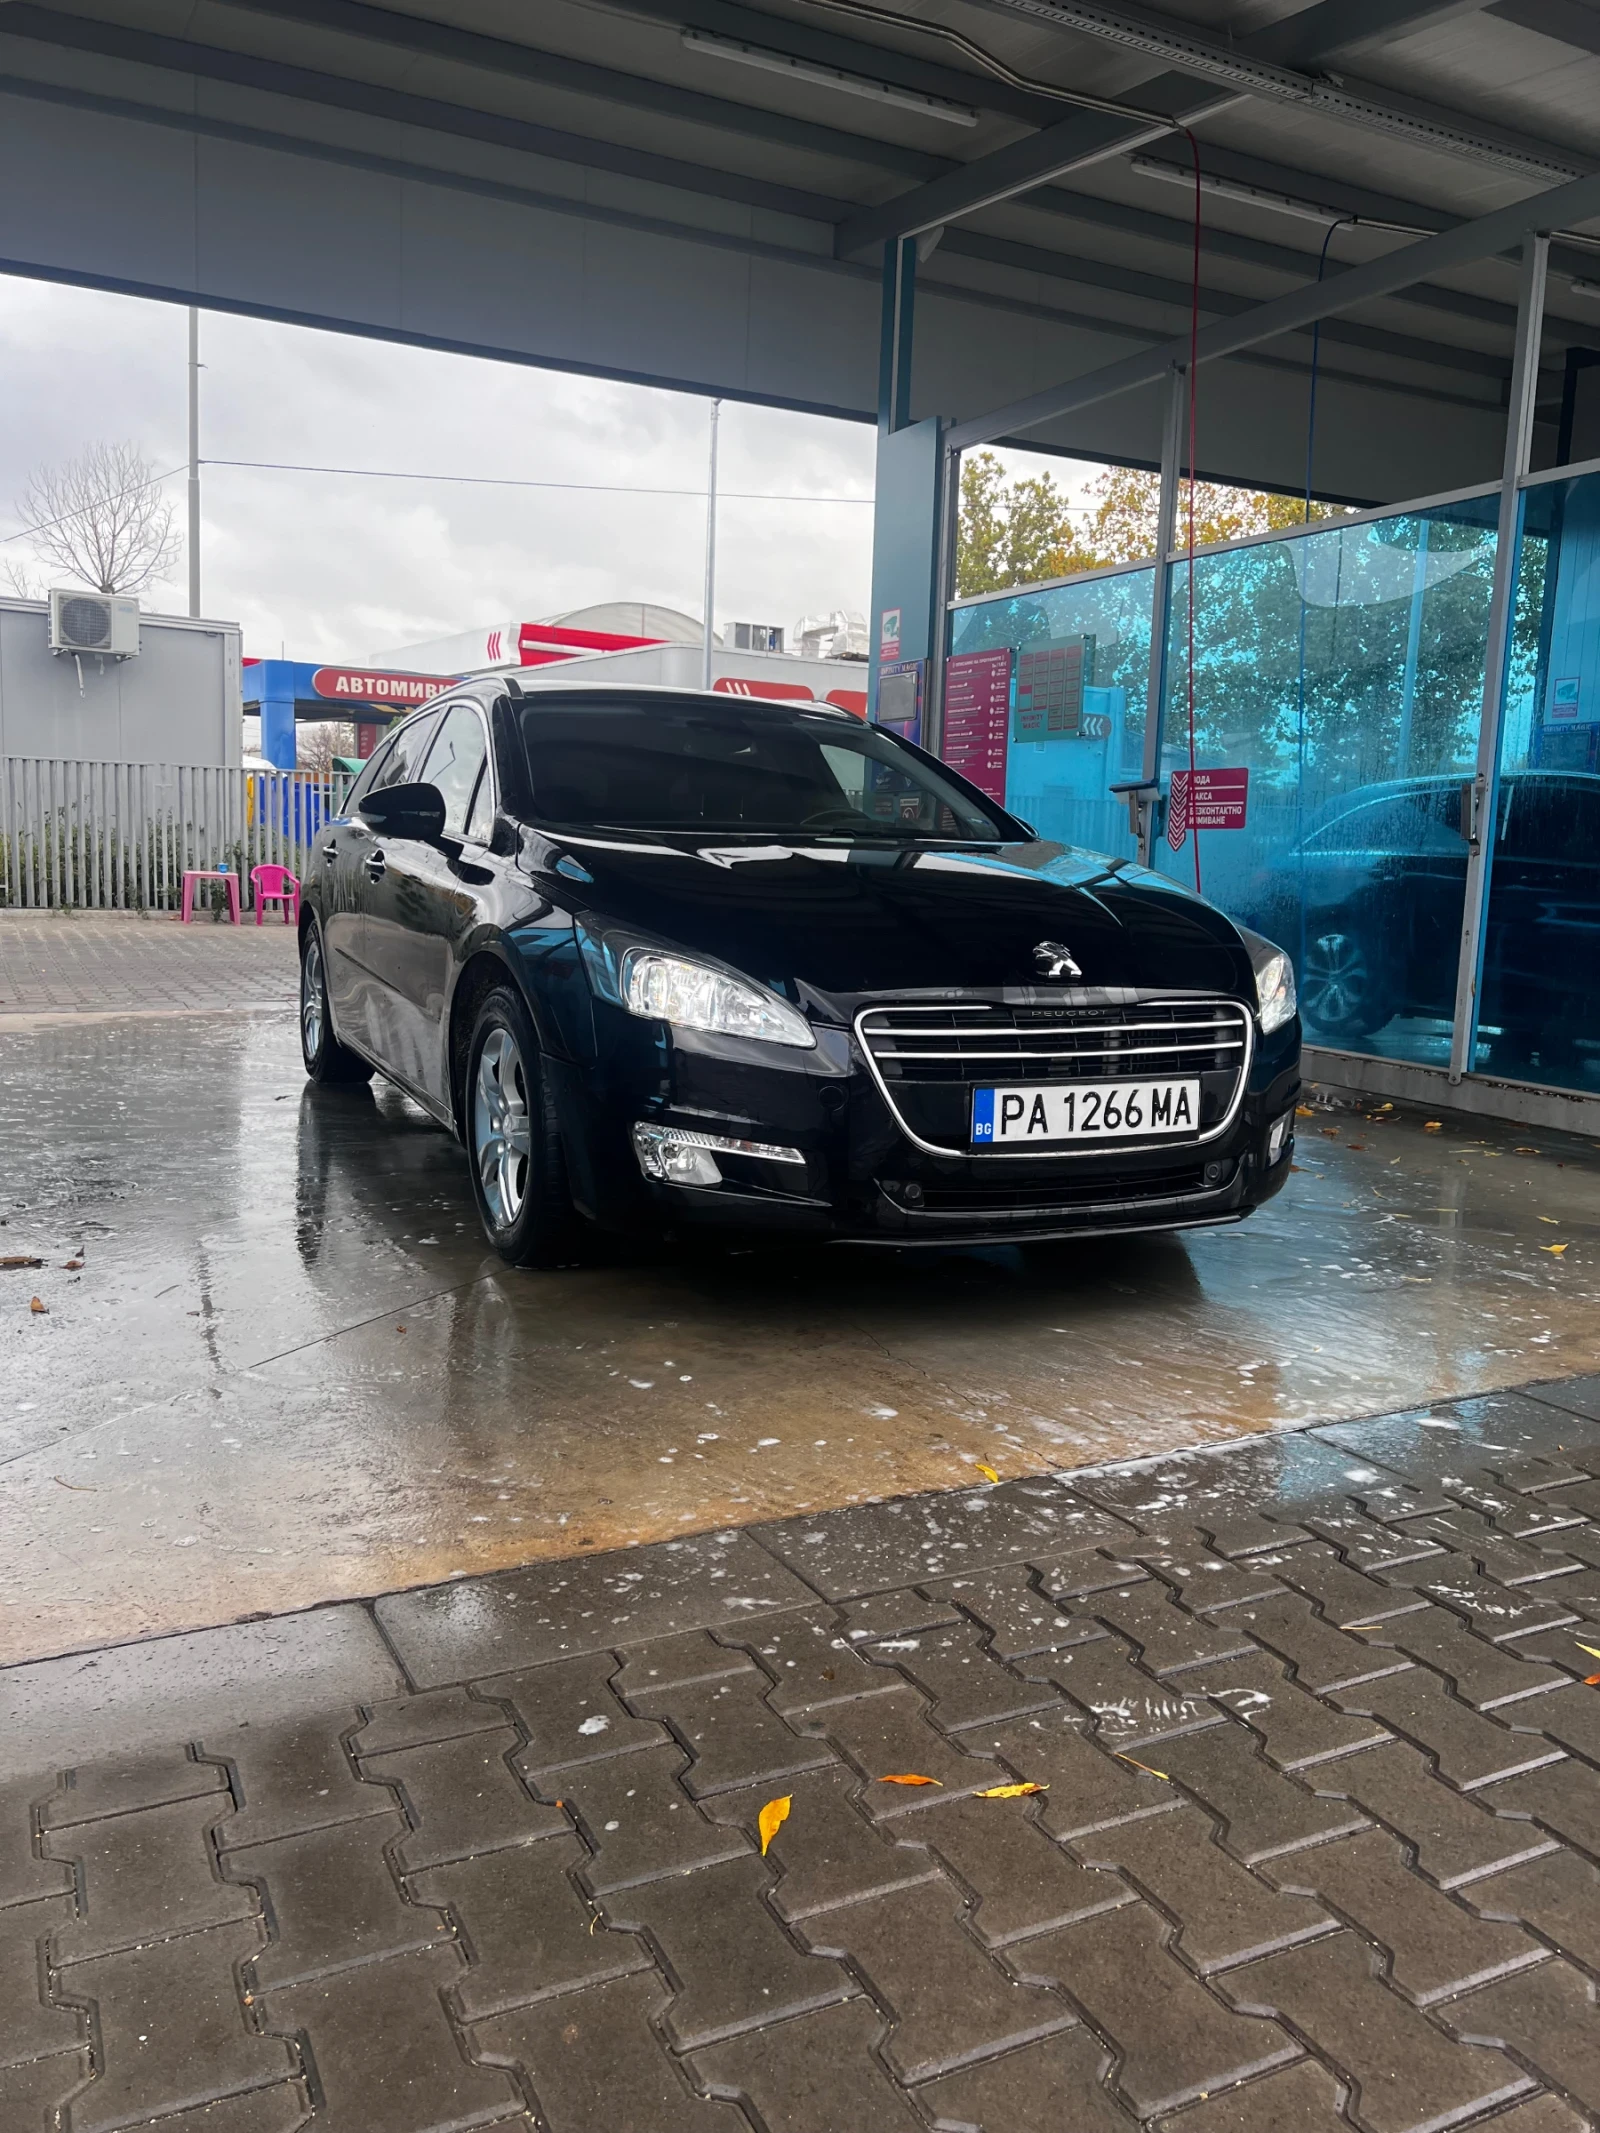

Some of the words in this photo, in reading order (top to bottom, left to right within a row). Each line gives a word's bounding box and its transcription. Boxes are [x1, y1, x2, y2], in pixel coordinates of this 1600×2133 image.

[1031, 1009, 1107, 1017] PEUGEOT
[1000, 1093, 1048, 1135] PA
[1063, 1088, 1143, 1132] 1266
[1151, 1086, 1192, 1127] MA
[975, 1123, 992, 1136] BG
